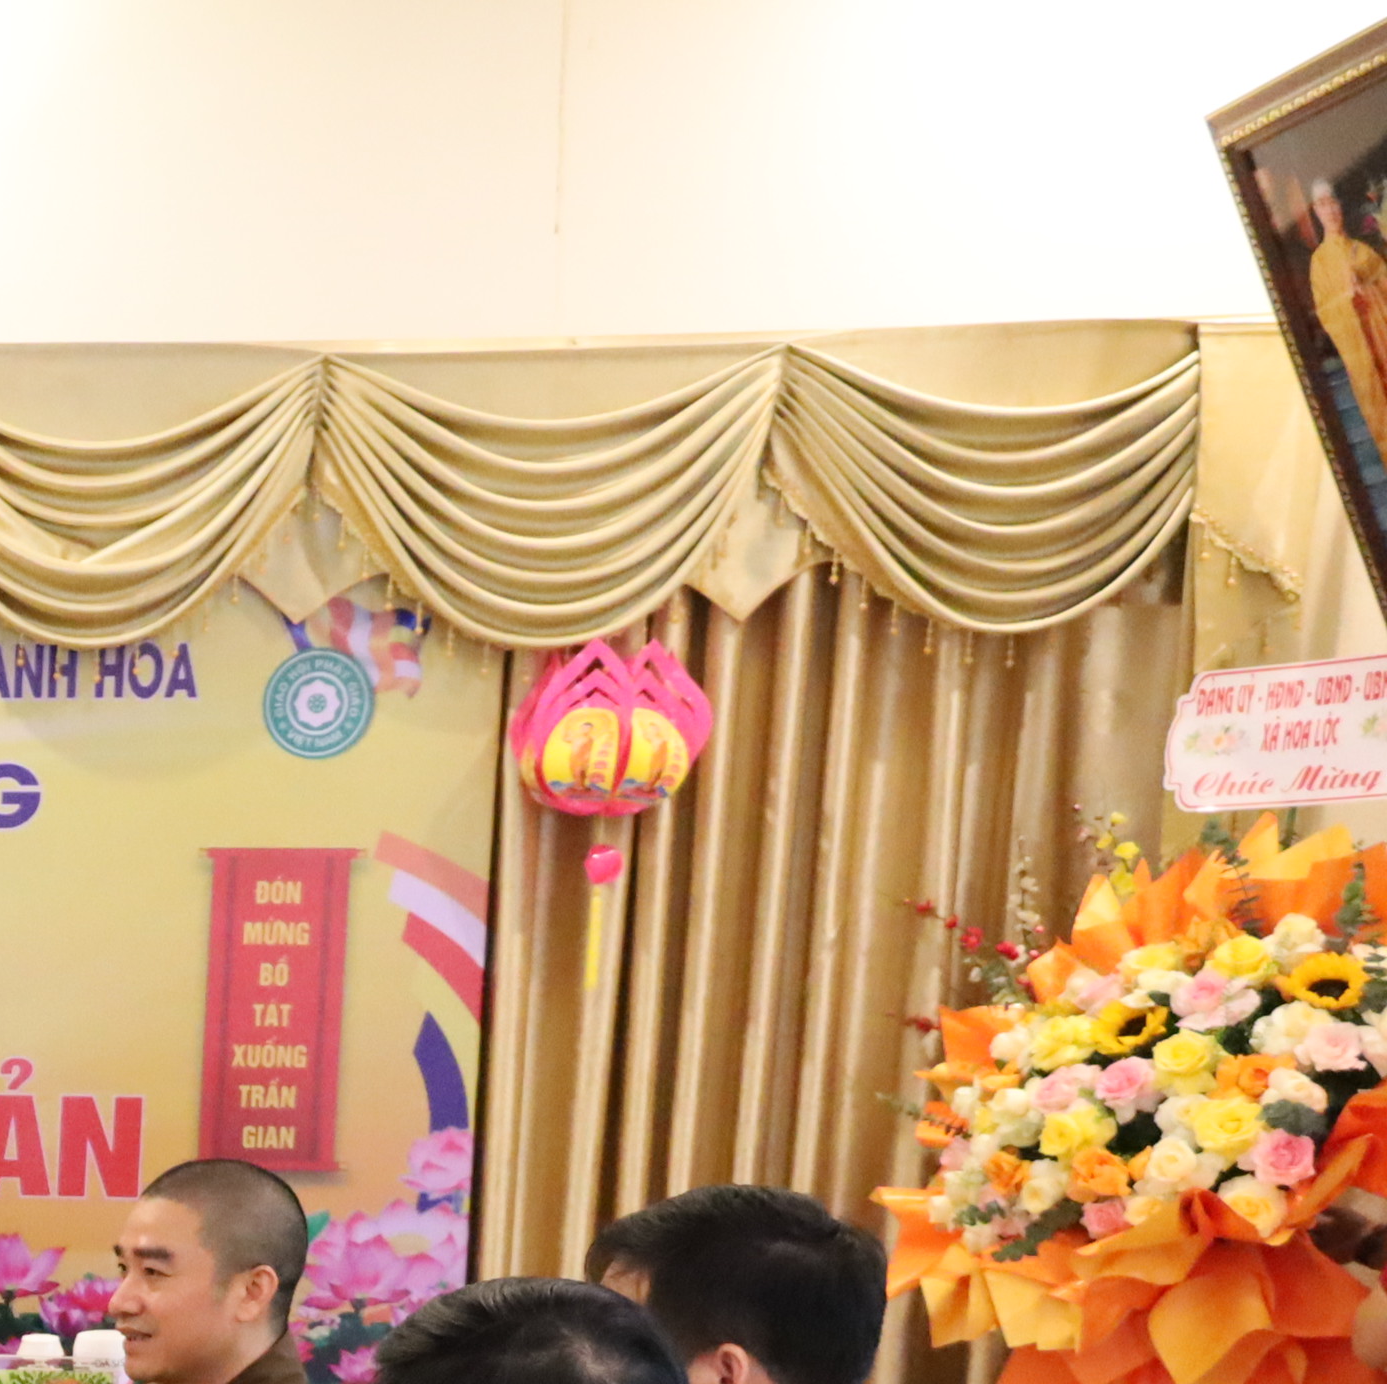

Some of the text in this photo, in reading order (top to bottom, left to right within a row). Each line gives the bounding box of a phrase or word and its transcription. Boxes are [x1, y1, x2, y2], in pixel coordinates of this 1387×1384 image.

[1193, 763, 1381, 798] Chúc Mừng
[255, 874, 303, 905] ĐÓN
[241, 1125, 296, 1150] GIAN
